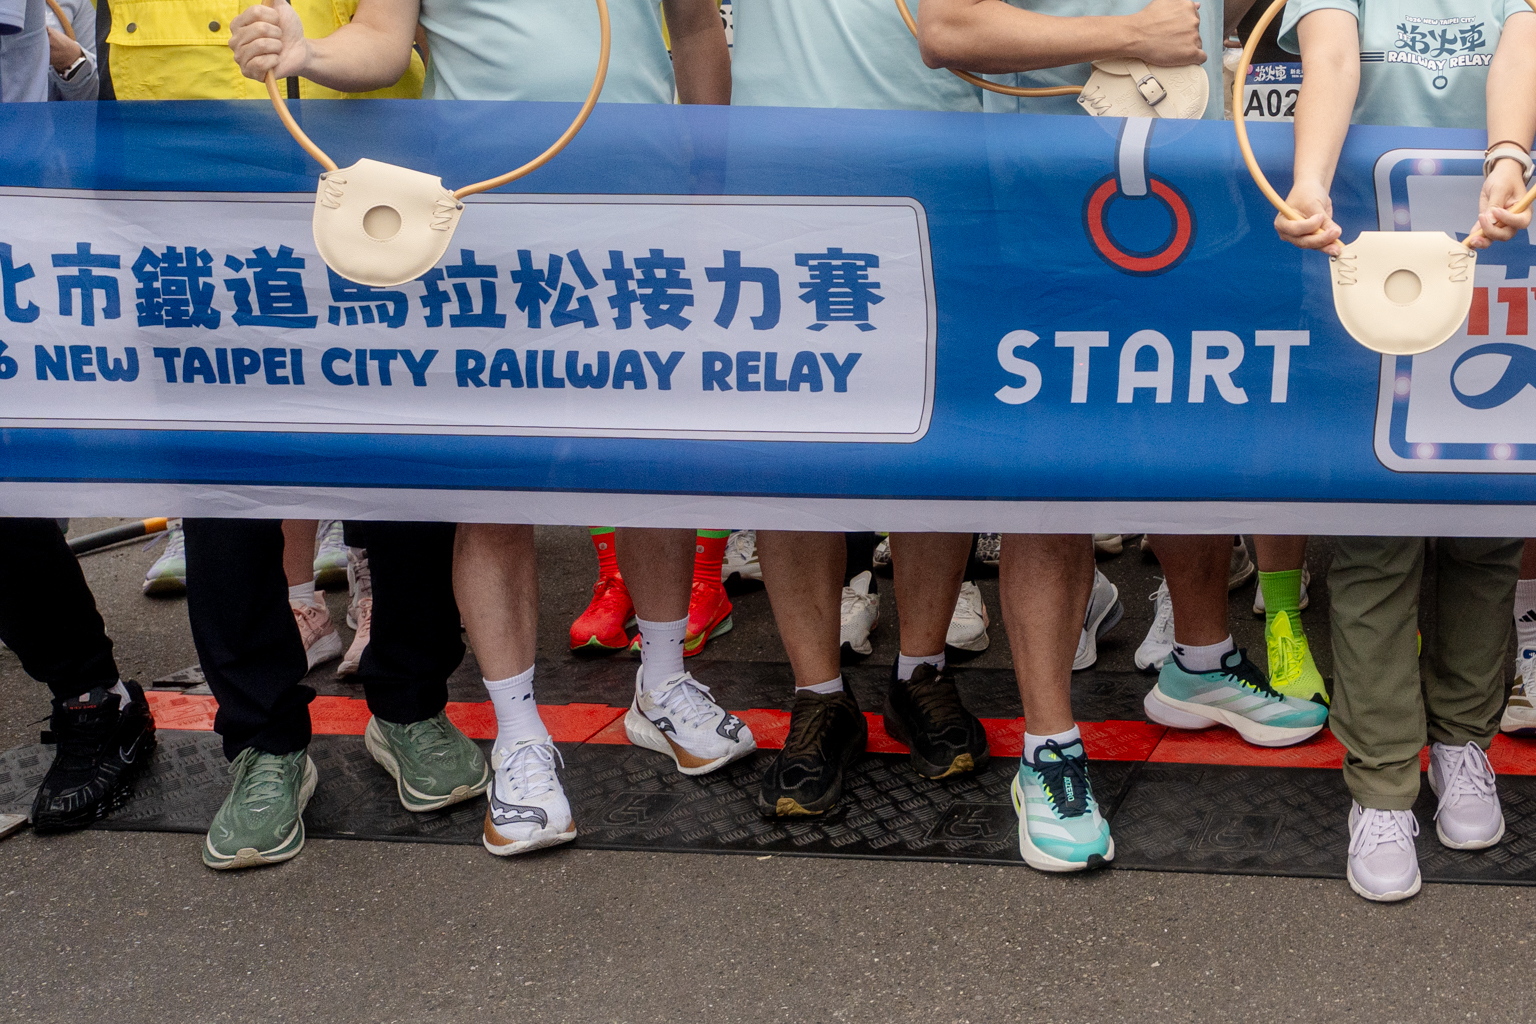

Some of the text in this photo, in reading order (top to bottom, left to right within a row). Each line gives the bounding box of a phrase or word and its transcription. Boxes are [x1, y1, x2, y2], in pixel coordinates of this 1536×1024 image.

[1423, 17, 1438, 25] NEW
[1440, 17, 1459, 25] TAIPEI
[1387, 51, 1493, 71] RAILWAY RELAY
[34, 344, 140, 382] NEW
[153, 346, 305, 386] TAIPEI
[322, 347, 439, 389] CITY
[456, 349, 685, 393] RAILWAY
[701, 350, 863, 394] RELAY
[994, 328, 1311, 406] START
